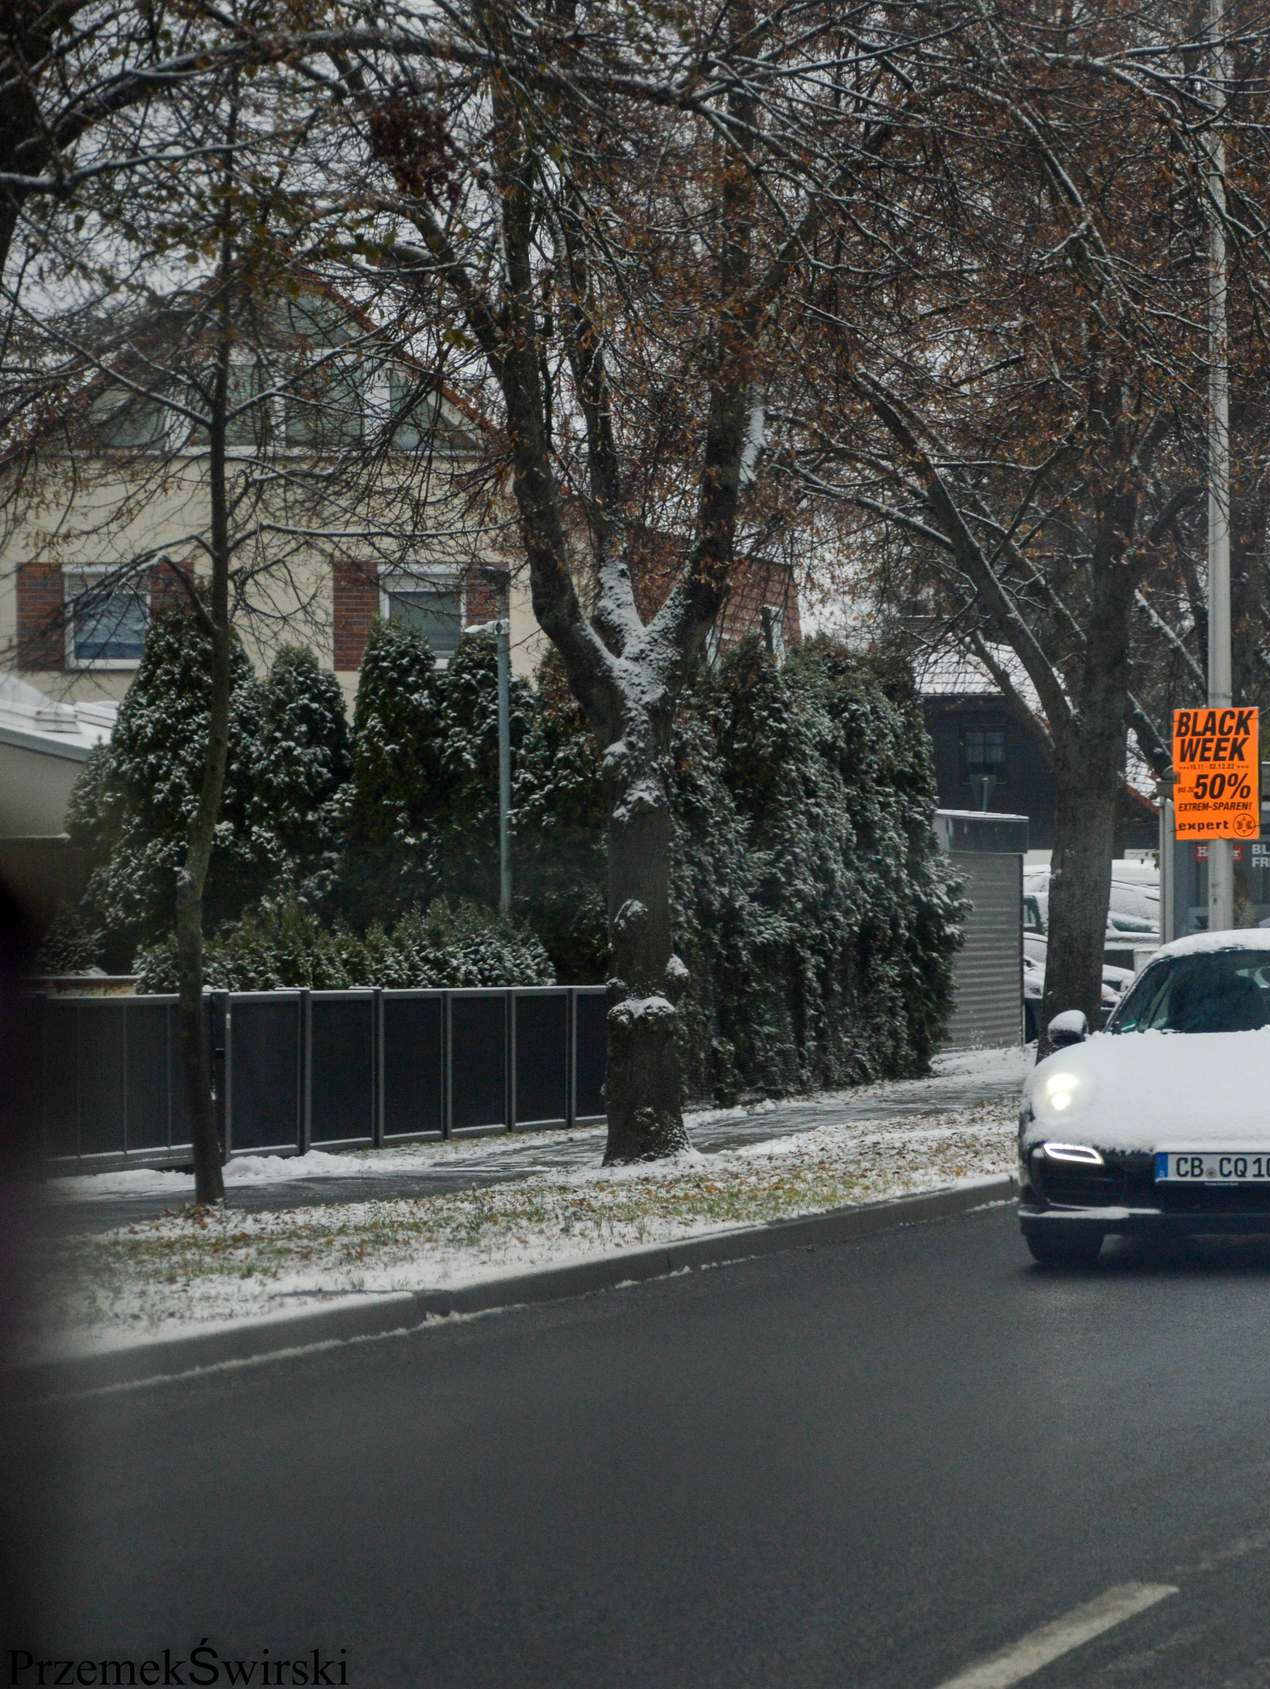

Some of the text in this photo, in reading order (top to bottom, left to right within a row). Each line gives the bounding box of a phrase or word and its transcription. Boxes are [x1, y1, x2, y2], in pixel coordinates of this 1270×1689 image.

[1175, 710, 1254, 737] BLACK
[1180, 737, 1249, 762] WEEK
[1193, 773, 1251, 799] 50%
[1178, 802, 1252, 812] EXTREM-SPAREN!
[1178, 820, 1229, 832] expert
[1176, 1157, 1205, 1178] CB
[1219, 1157, 1248, 1178] CQ
